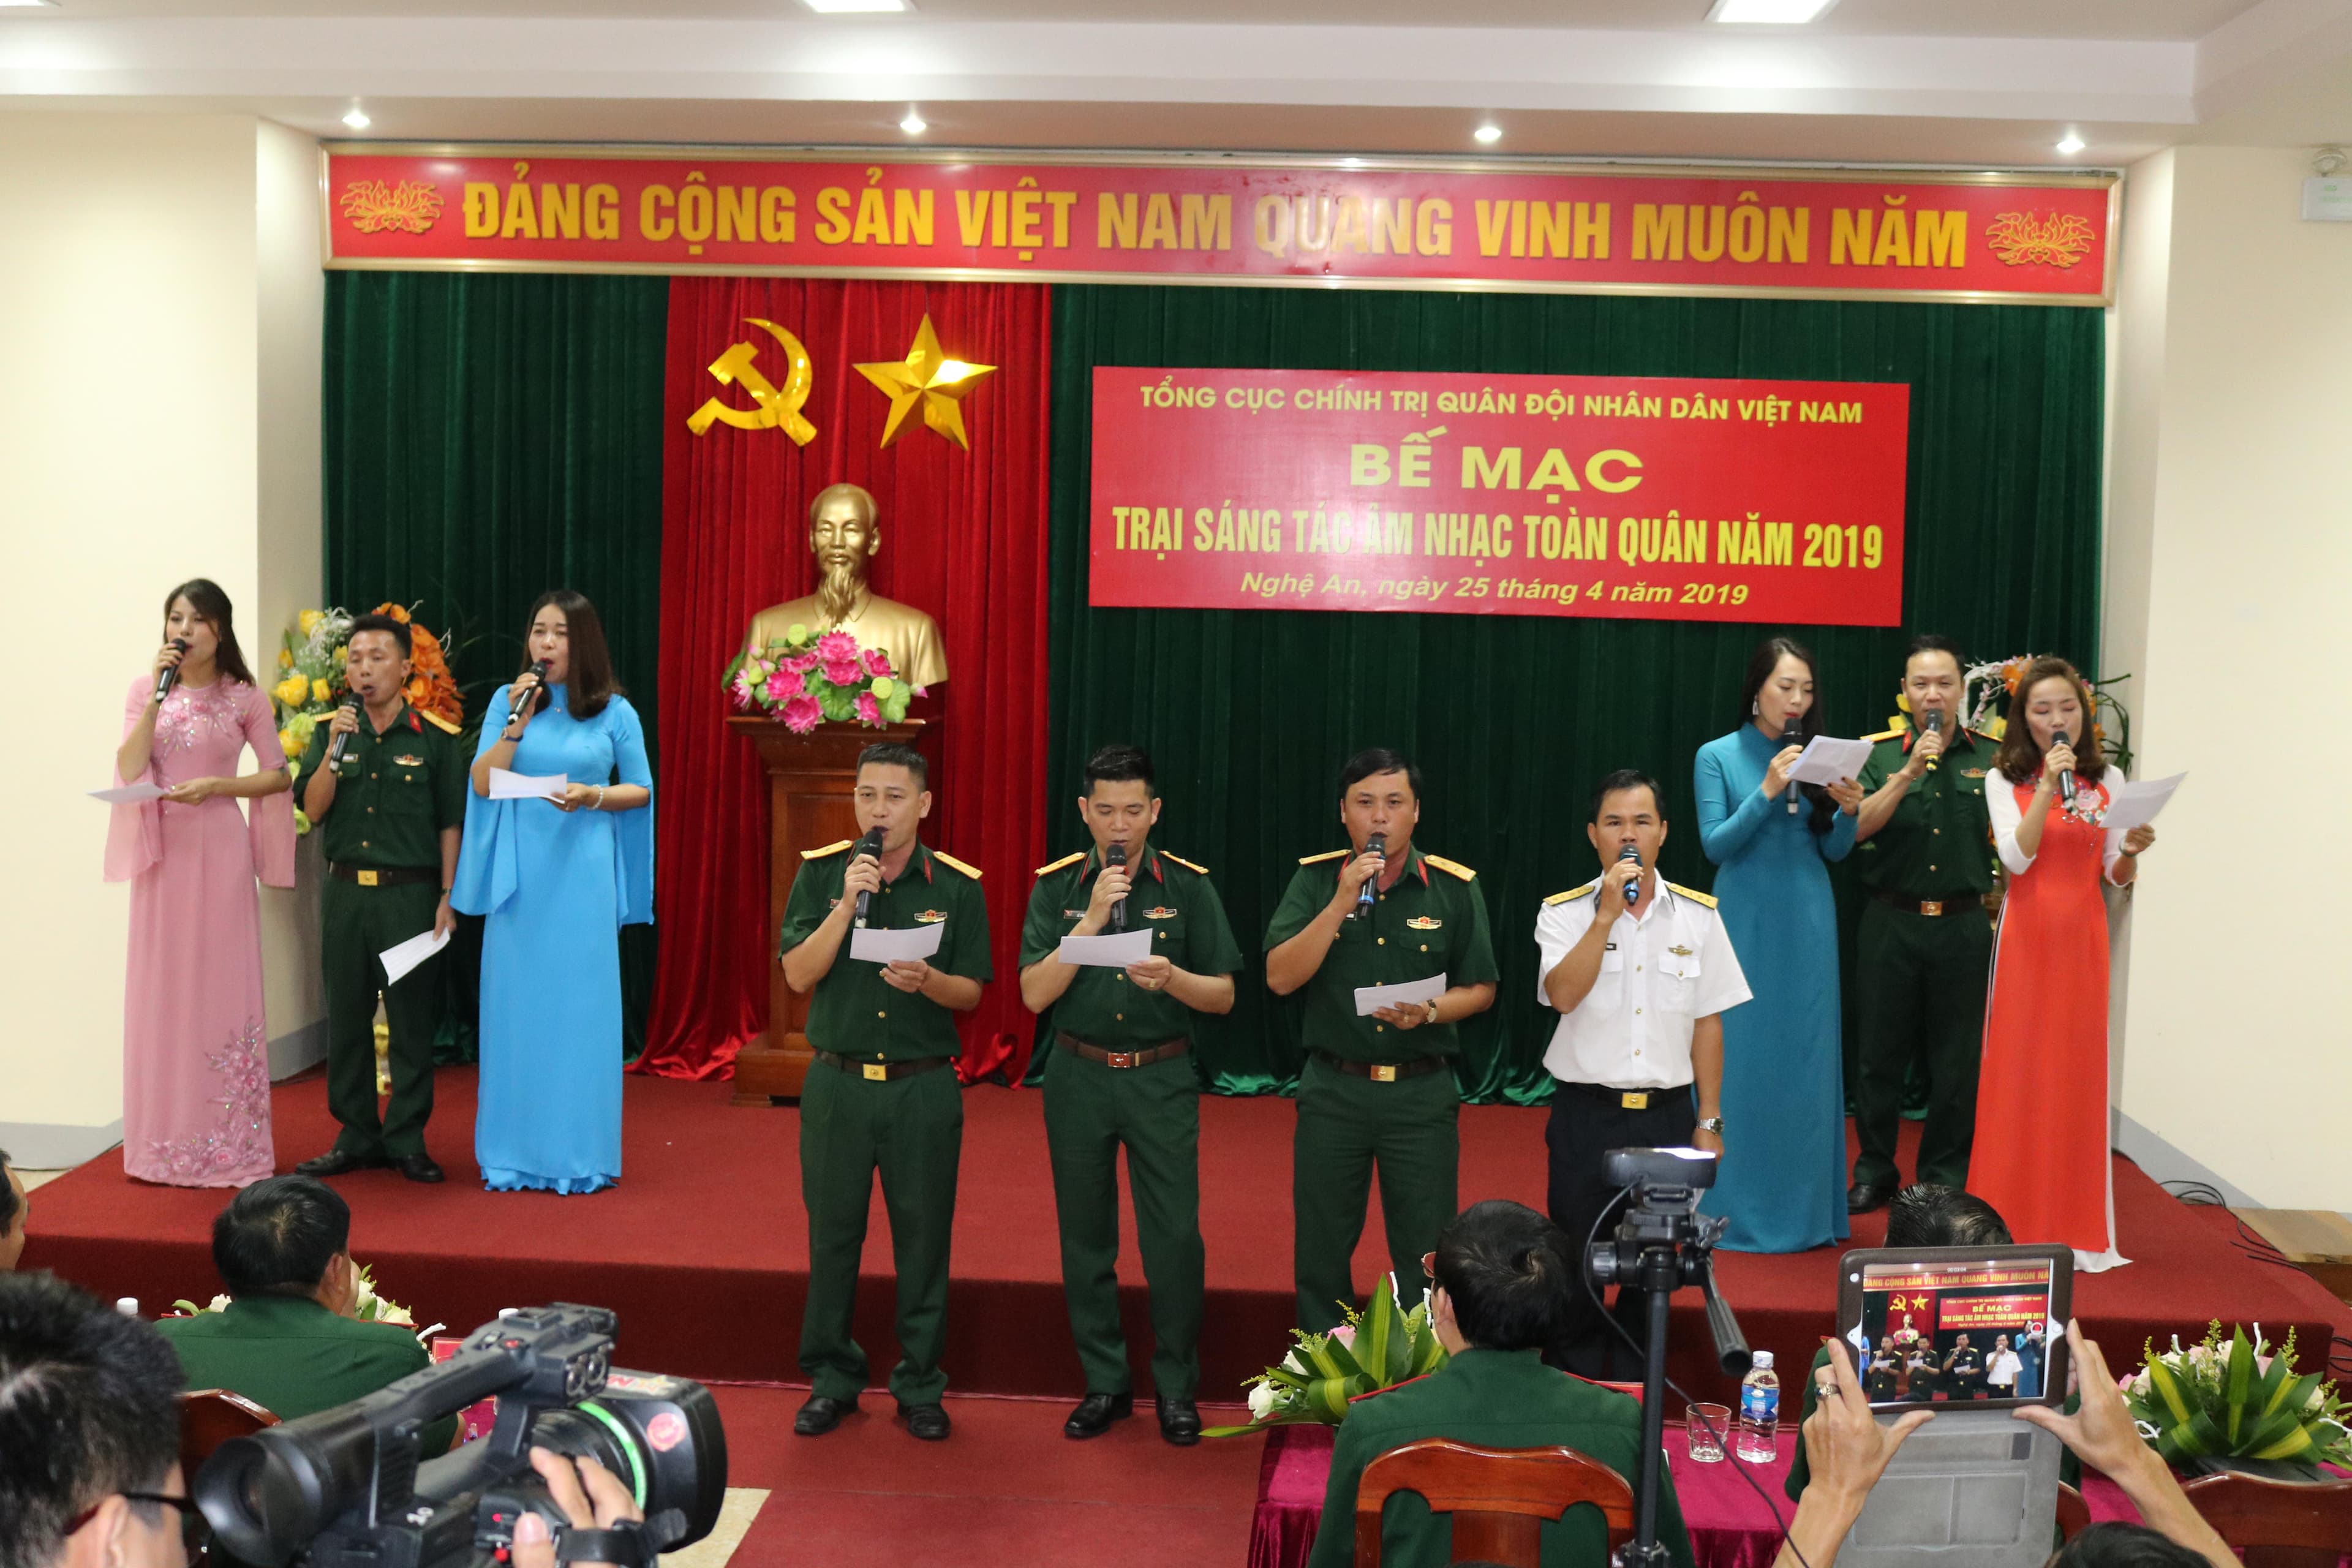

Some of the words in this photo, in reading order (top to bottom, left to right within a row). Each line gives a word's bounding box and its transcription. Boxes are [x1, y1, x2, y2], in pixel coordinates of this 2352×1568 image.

[462, 161, 620, 239] ĐẢNG
[640, 171, 796, 255] CỘNG
[815, 167, 933, 246] SẢN
[955, 176, 1077, 261] VIỆT
[1098, 192, 1232, 250] NAM
[1254, 195, 1452, 258] QUANG
[1475, 200, 1611, 259] VINH
[1631, 191, 1809, 263] MUÔN
[1830, 195, 1967, 268] NĂM
[1140, 375, 1216, 409] TỔNG
[1225, 388, 1285, 415] CỤC
[1294, 384, 1382, 411] CHÍNH
[1390, 390, 1428, 418] TRỊ
[1436, 387, 1517, 414] QUÂN
[1525, 388, 1575, 421] ĐỘI
[1583, 390, 1662, 418] NHÂN
[1670, 392, 1729, 420] DÂN
[1737, 394, 1792, 428] VIỆT
[1800, 401, 1863, 424] NAM
[1350, 425, 1448, 488] BẾ
[1461, 446, 1644, 505] MẠC
[1112, 506, 1183, 561] TRẠI
[1194, 499, 1281, 553] SÁNG
[1292, 501, 1352, 555] TÁC
[1362, 503, 1413, 556] ÂM
[1425, 513, 1513, 567] NHẠC
[1523, 507, 1608, 562] TOÀN
[1618, 510, 1708, 567] QUÂN
[1717, 512, 1793, 566] NĂM
[1803, 523, 1883, 570] 2019
[1240, 572, 1314, 598] Nghệ
[1322, 575, 1367, 597] An,
[1378, 576, 1447, 601] ngày
[1454, 577, 1491, 598] 25
[1497, 578, 1579, 605] tháng
[1585, 581, 1604, 601] 4
[1610, 581, 1673, 603] năm
[1679, 583, 1749, 605] 2019
